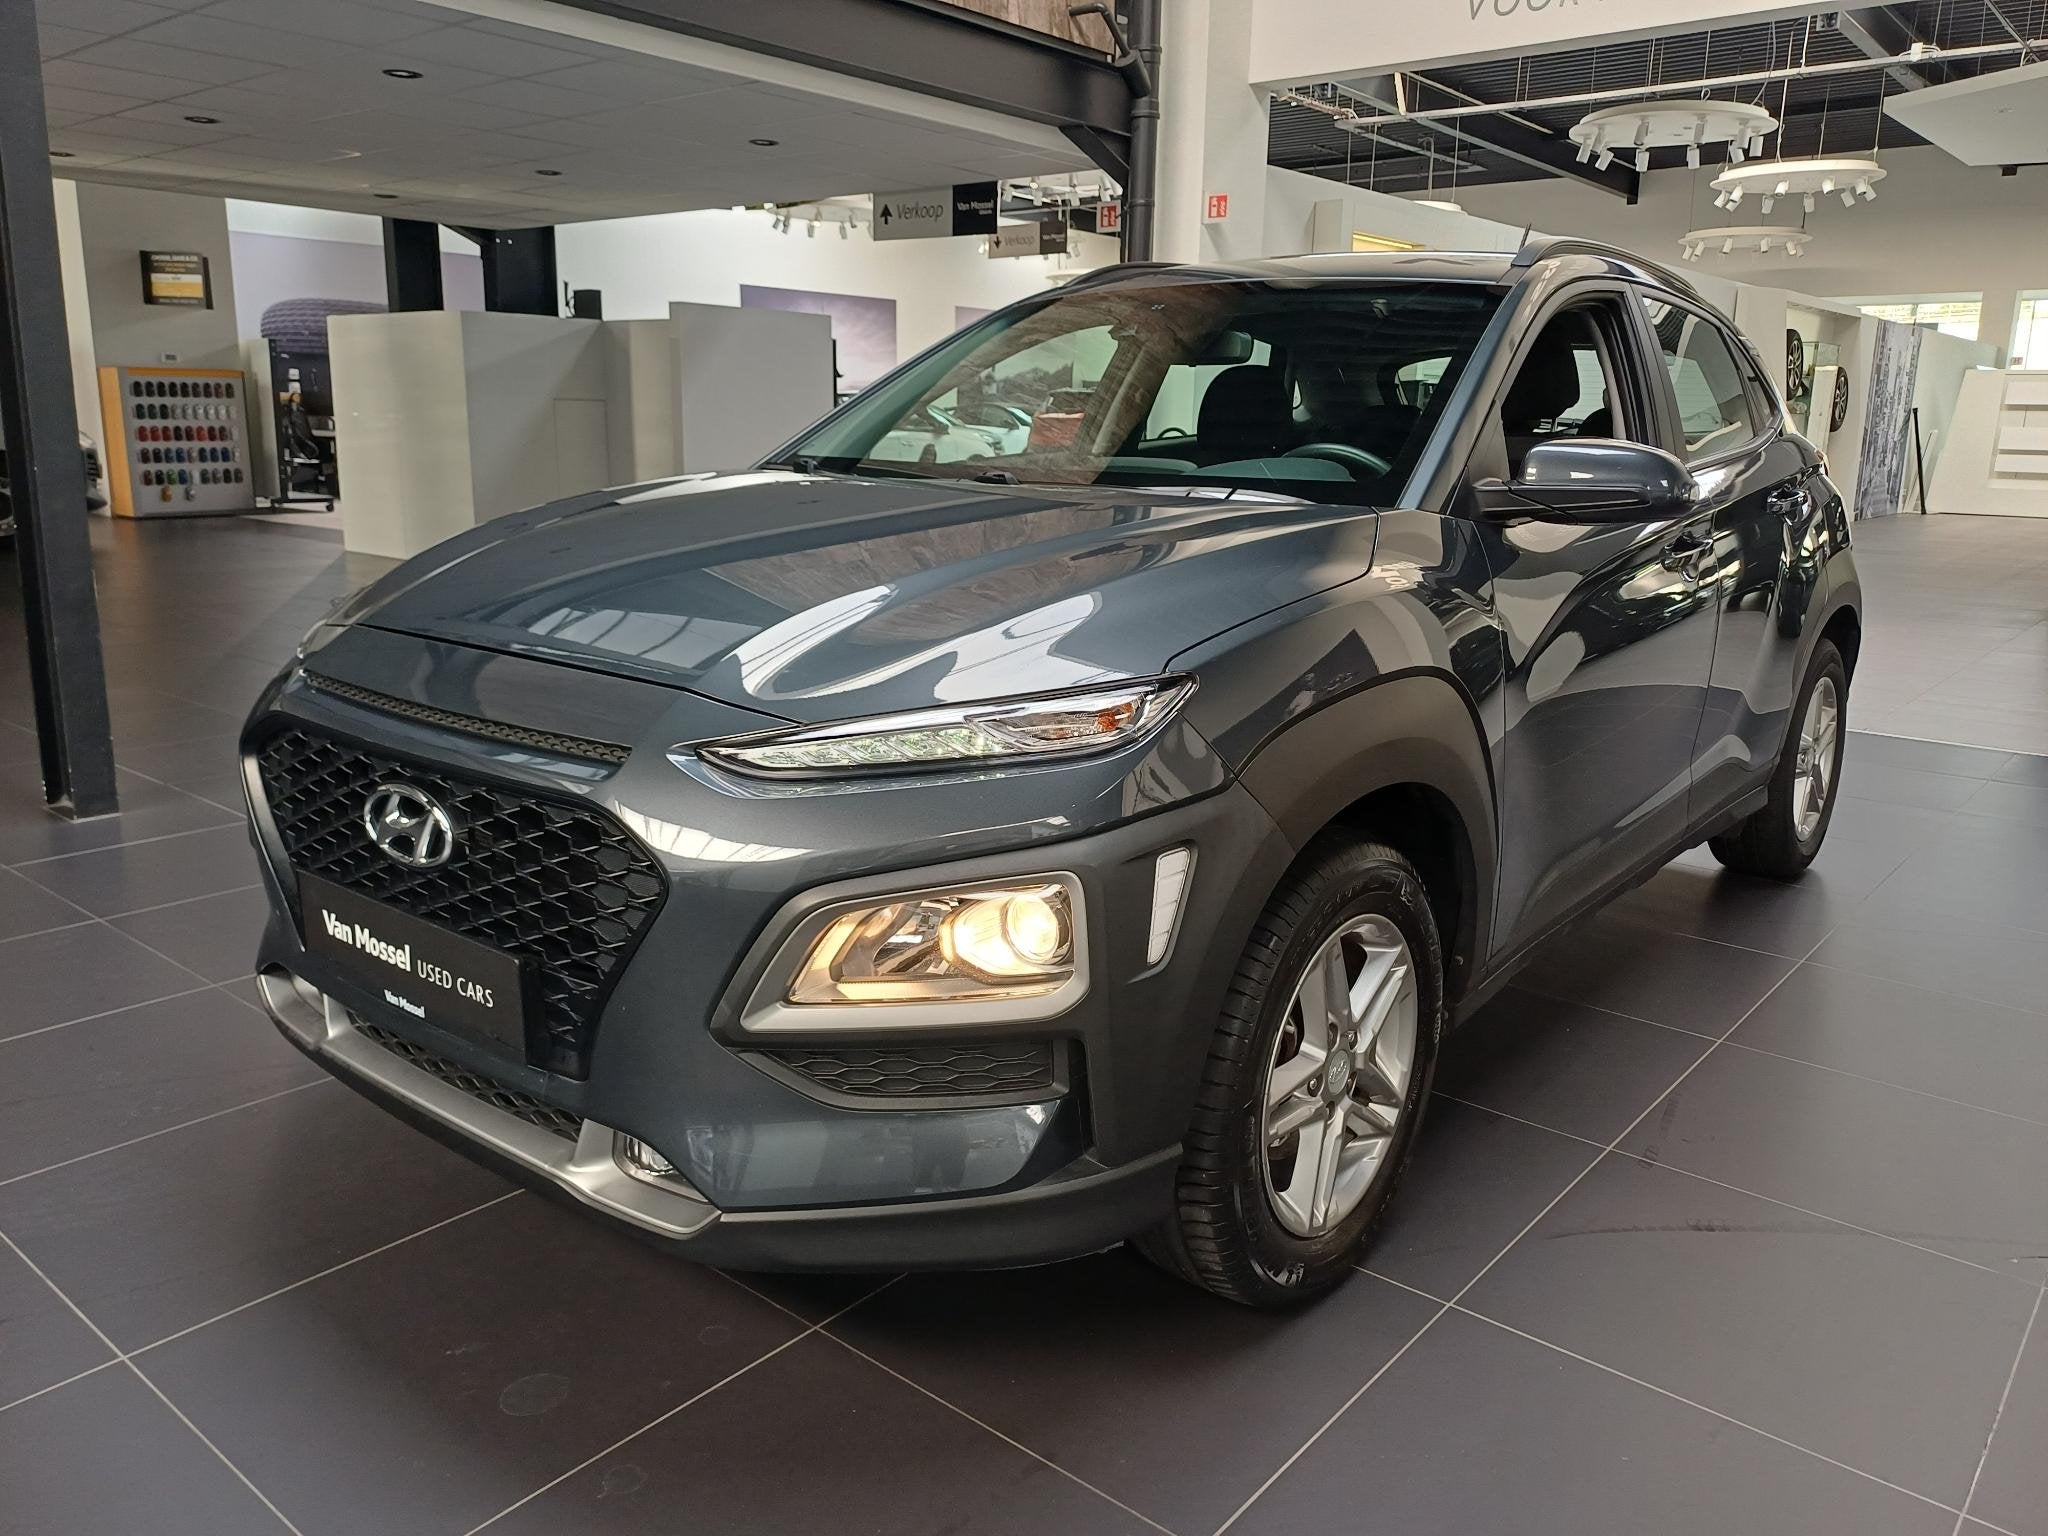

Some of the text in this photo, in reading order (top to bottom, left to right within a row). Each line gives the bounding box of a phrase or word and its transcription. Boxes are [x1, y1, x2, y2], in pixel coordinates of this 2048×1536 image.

[896, 203, 943, 223] Verkoop
[322, 909, 494, 1008] Van Mossel USED CARS
[384, 989, 399, 1006] Van
